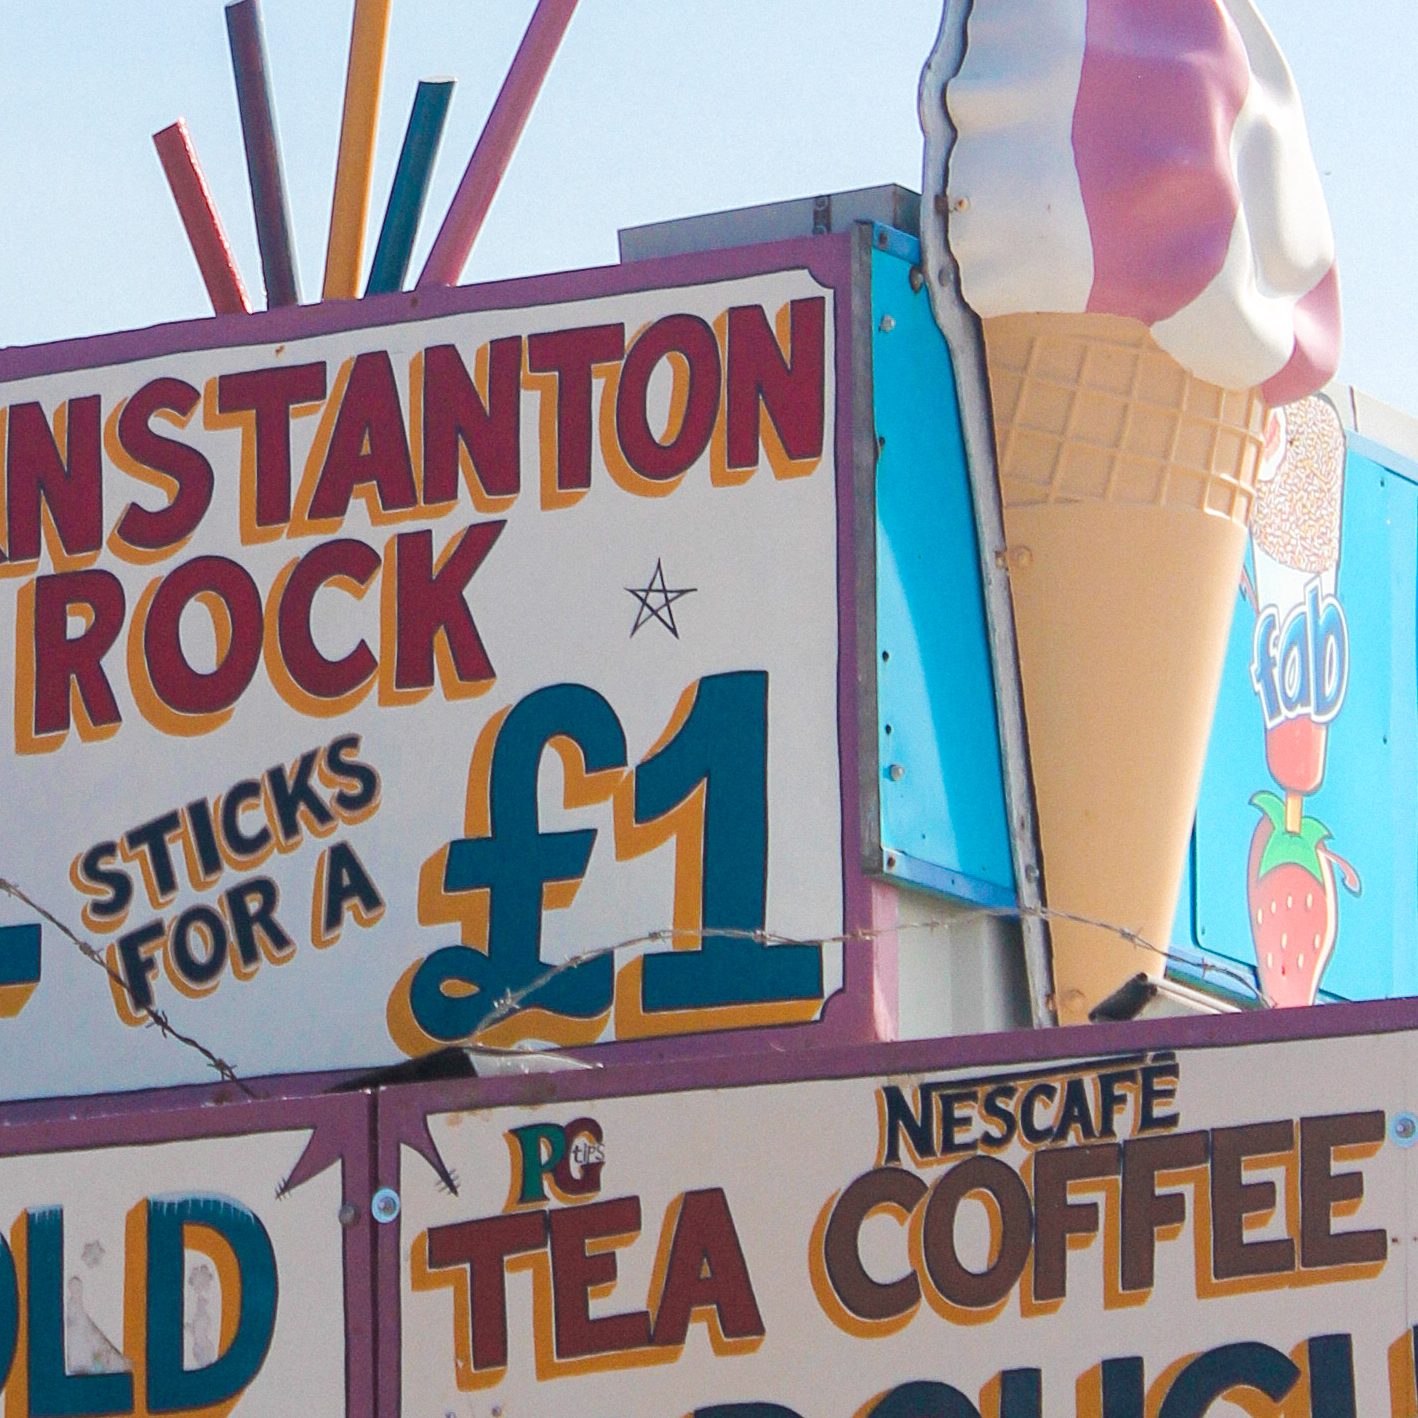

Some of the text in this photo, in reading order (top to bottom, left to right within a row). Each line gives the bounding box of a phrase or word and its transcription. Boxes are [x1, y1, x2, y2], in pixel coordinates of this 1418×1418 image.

[16, 519, 508, 754] ROCK
[1251, 576, 1349, 728] fab
[69, 733, 381, 937] STICKS
[109, 841, 384, 1030] FOR A
[388, 669, 824, 1059] £1
[502, 1117, 605, 1213] PG
[807, 1109, 1388, 1338] COFFEE
[410, 1186, 766, 1392] TEA
